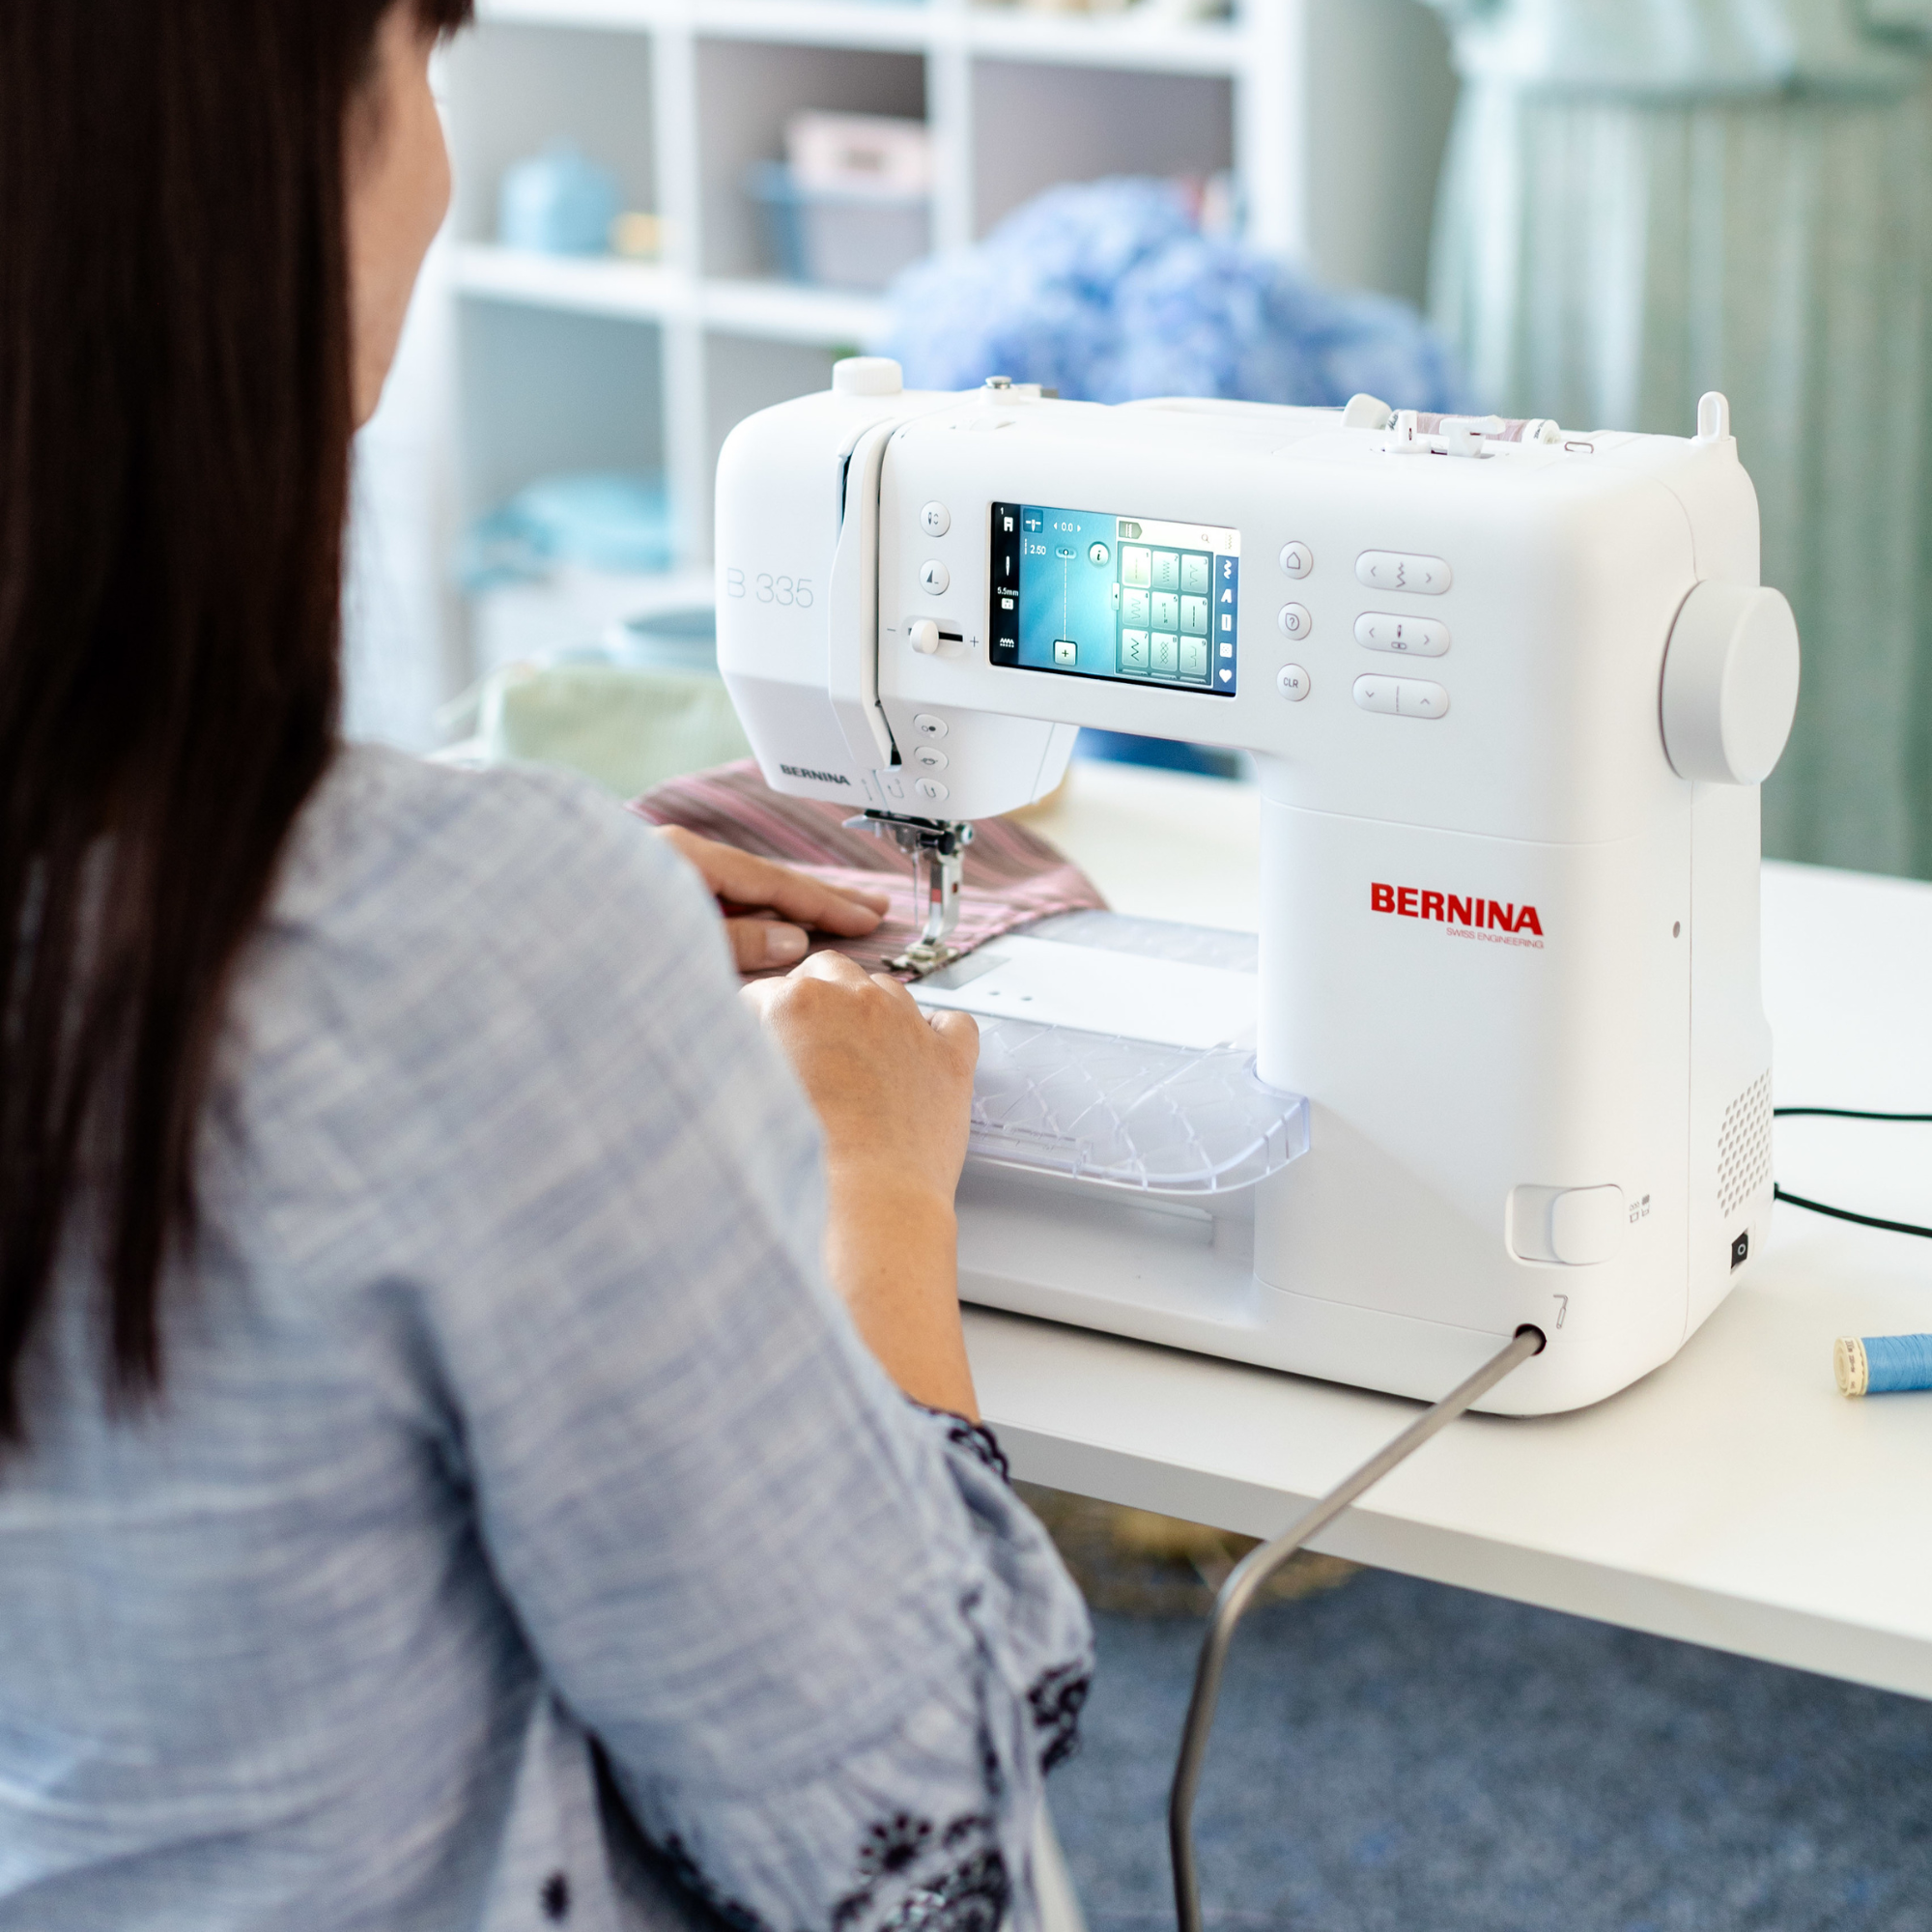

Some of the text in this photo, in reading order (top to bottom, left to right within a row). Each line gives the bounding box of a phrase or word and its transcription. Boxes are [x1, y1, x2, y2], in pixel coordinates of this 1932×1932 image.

[1061, 522, 1073, 532] 0.0
[1030, 545, 1046, 554] 2.50
[727, 567, 813, 609] B 335
[997, 586, 1019, 596] 5.5mm
[1283, 677, 1299, 689] CLR
[780, 763, 851, 786] BERNINA
[1371, 882, 1544, 936] BERNINA
[1446, 926, 1545, 950] SWISS ENGINEERING
